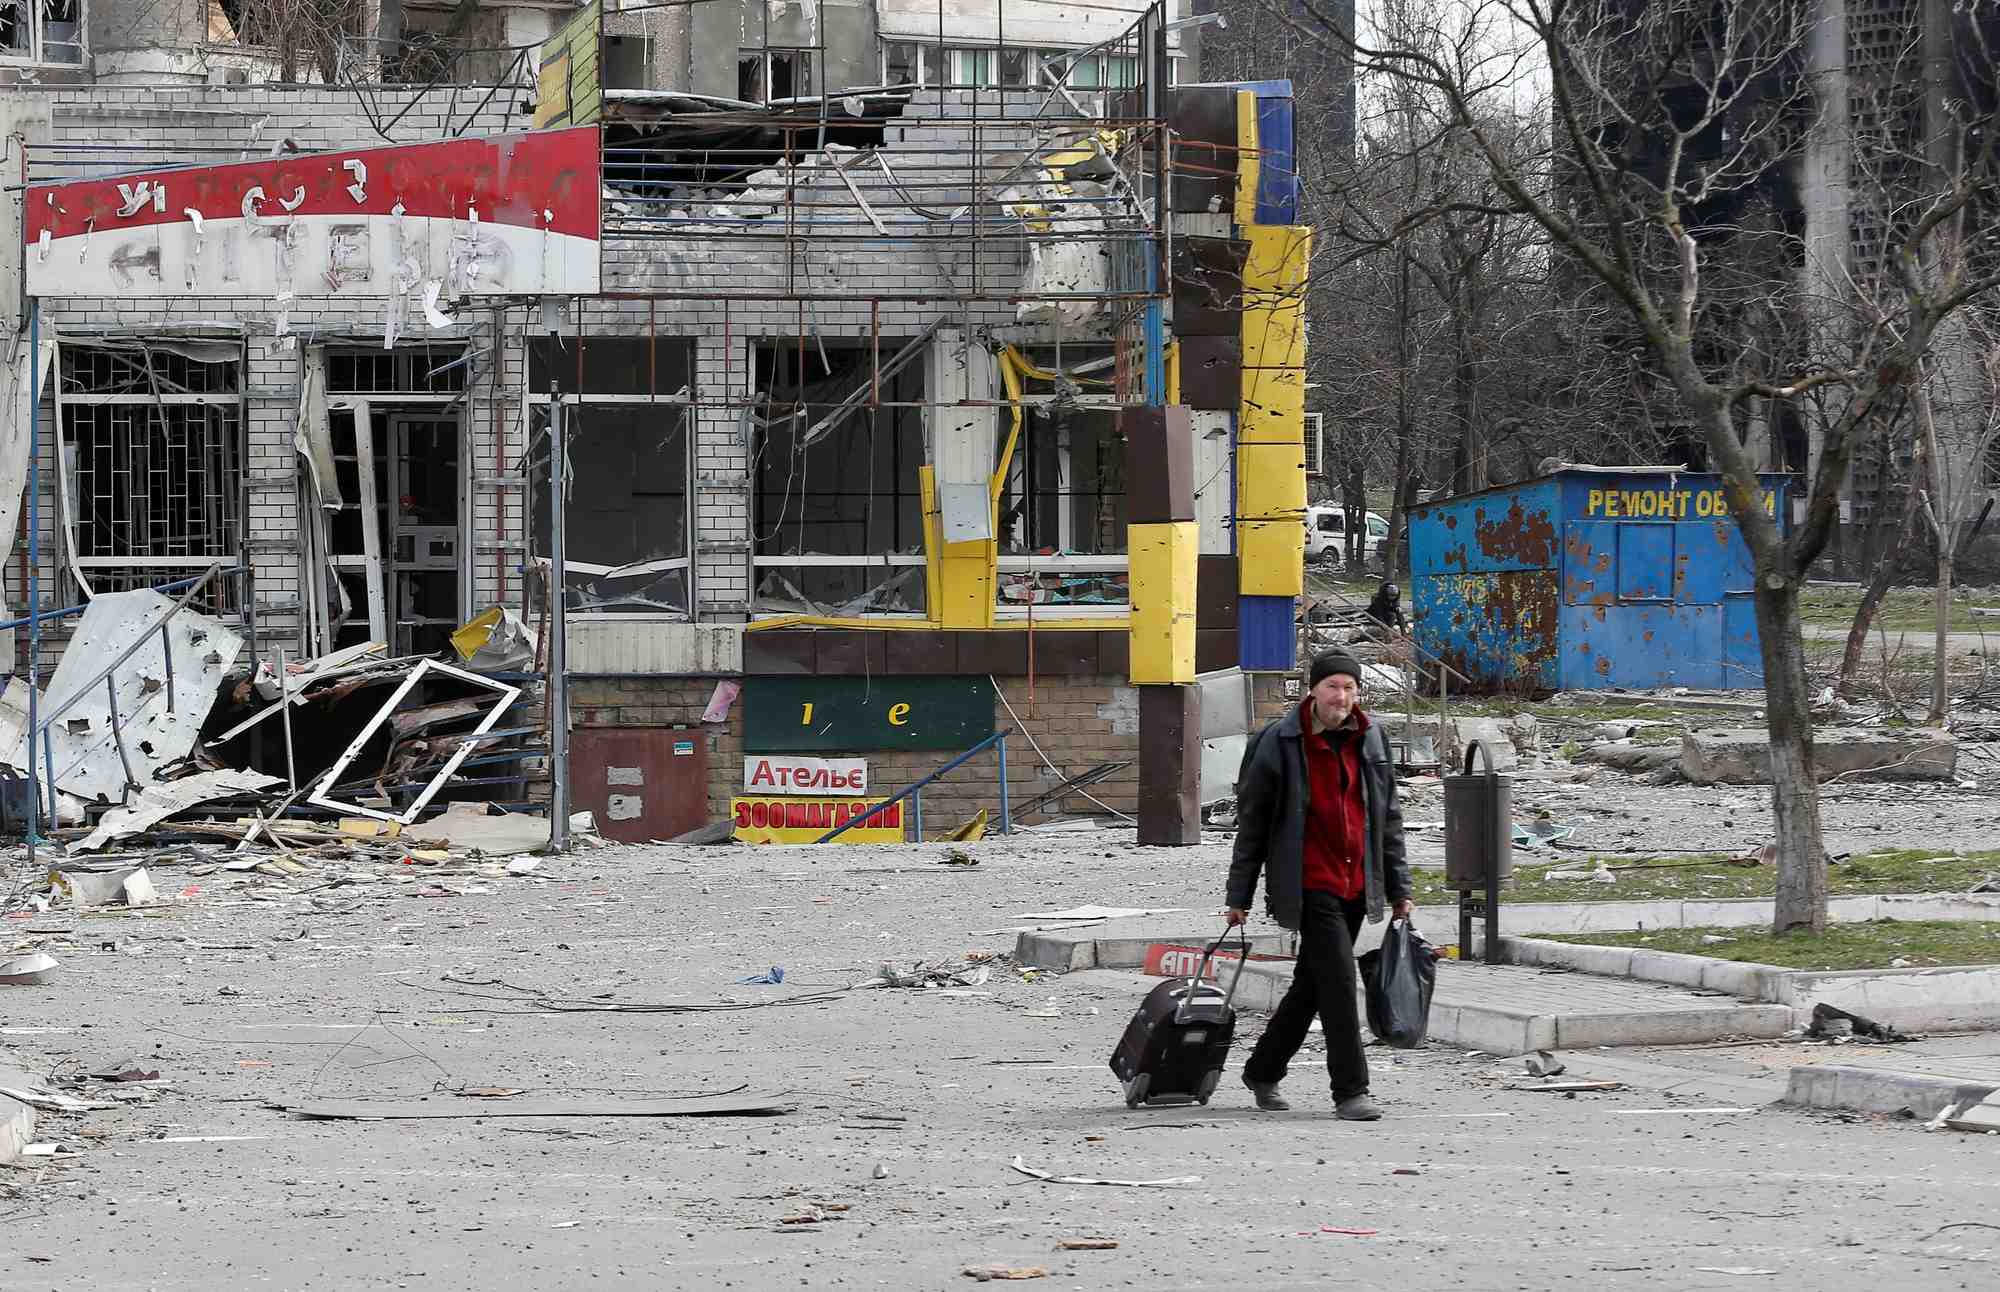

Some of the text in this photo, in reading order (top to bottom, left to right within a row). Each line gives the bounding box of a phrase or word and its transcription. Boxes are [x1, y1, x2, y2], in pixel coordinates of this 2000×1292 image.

[1588, 489, 1776, 518] РЕМОНТ ОБИ
[751, 760, 864, 788] Ательє
[735, 802, 900, 828] ЗООМАГАЗИН
